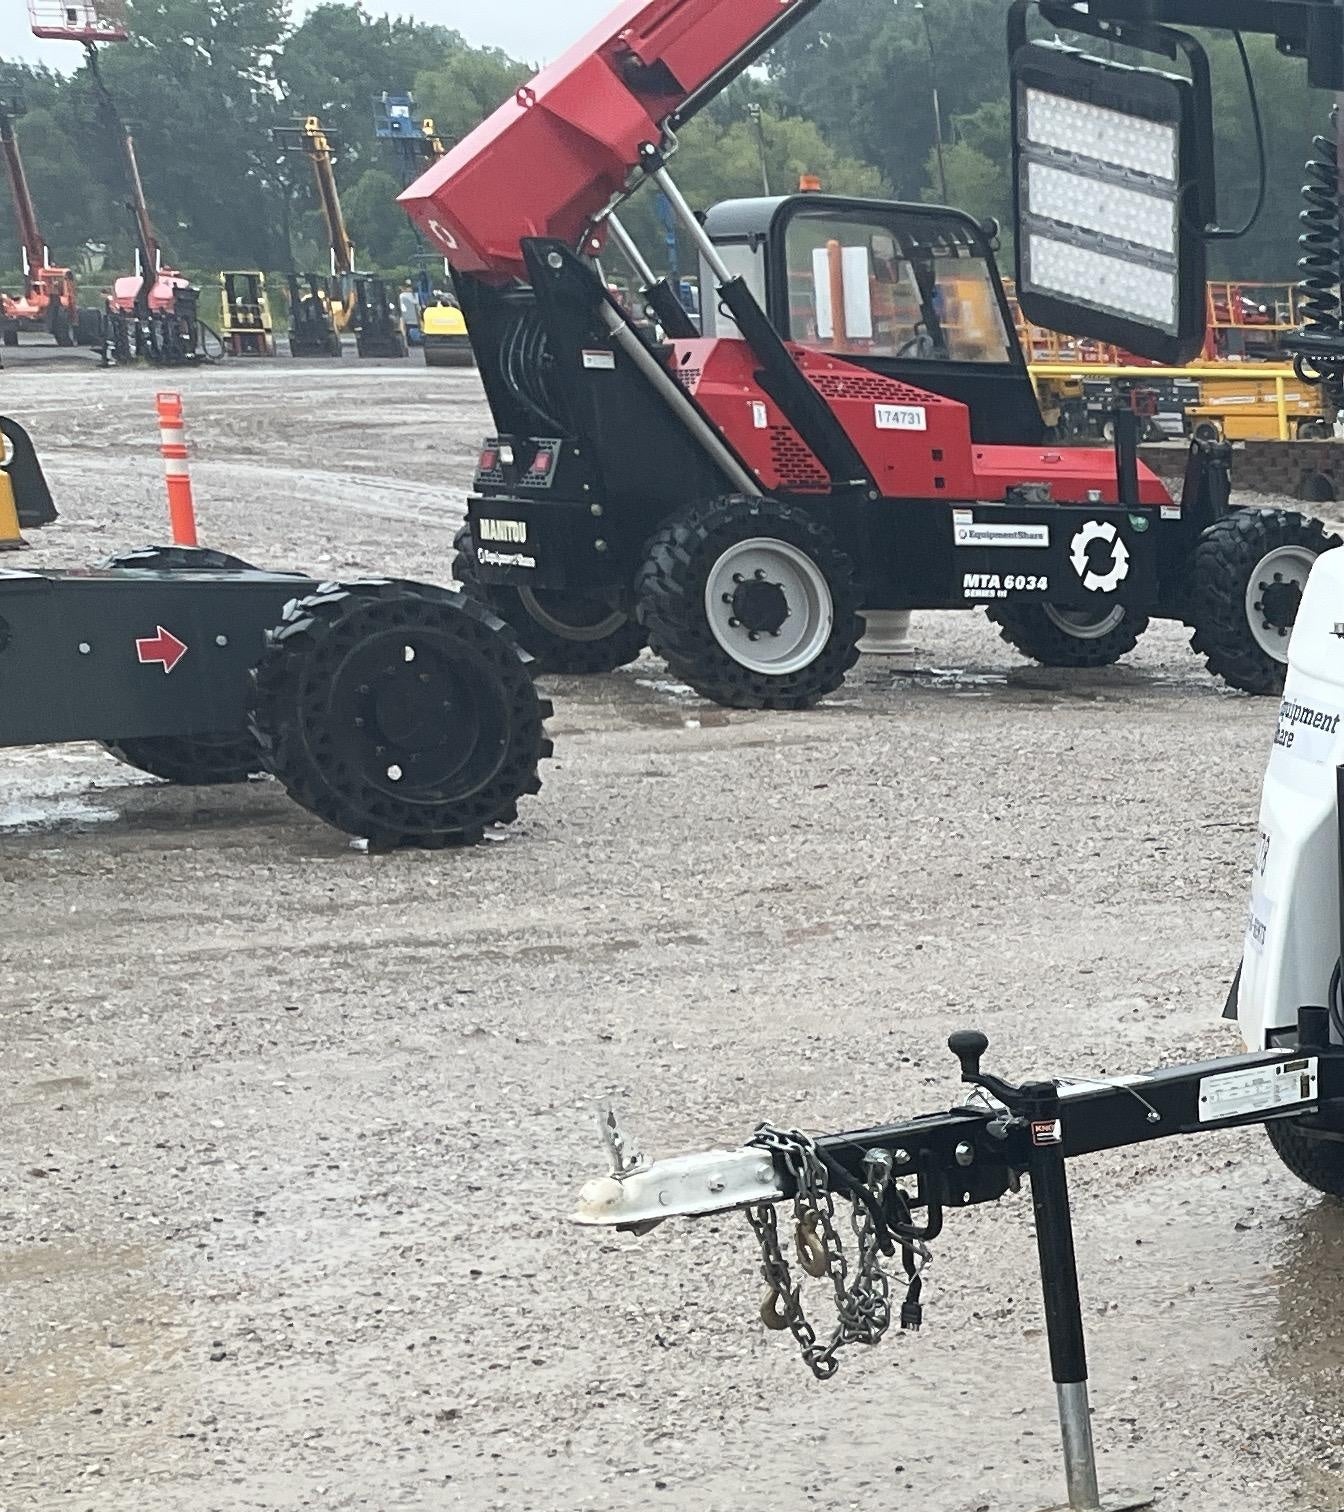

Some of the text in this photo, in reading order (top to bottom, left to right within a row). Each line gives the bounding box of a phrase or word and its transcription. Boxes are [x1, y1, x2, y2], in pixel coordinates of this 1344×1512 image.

[877, 408, 923, 426] 174731
[480, 518, 527, 543] MANITOU
[968, 528, 1045, 542] EquipmentShare
[962, 573, 1049, 591] MTA 6034
[1279, 696, 1341, 734] quipment
